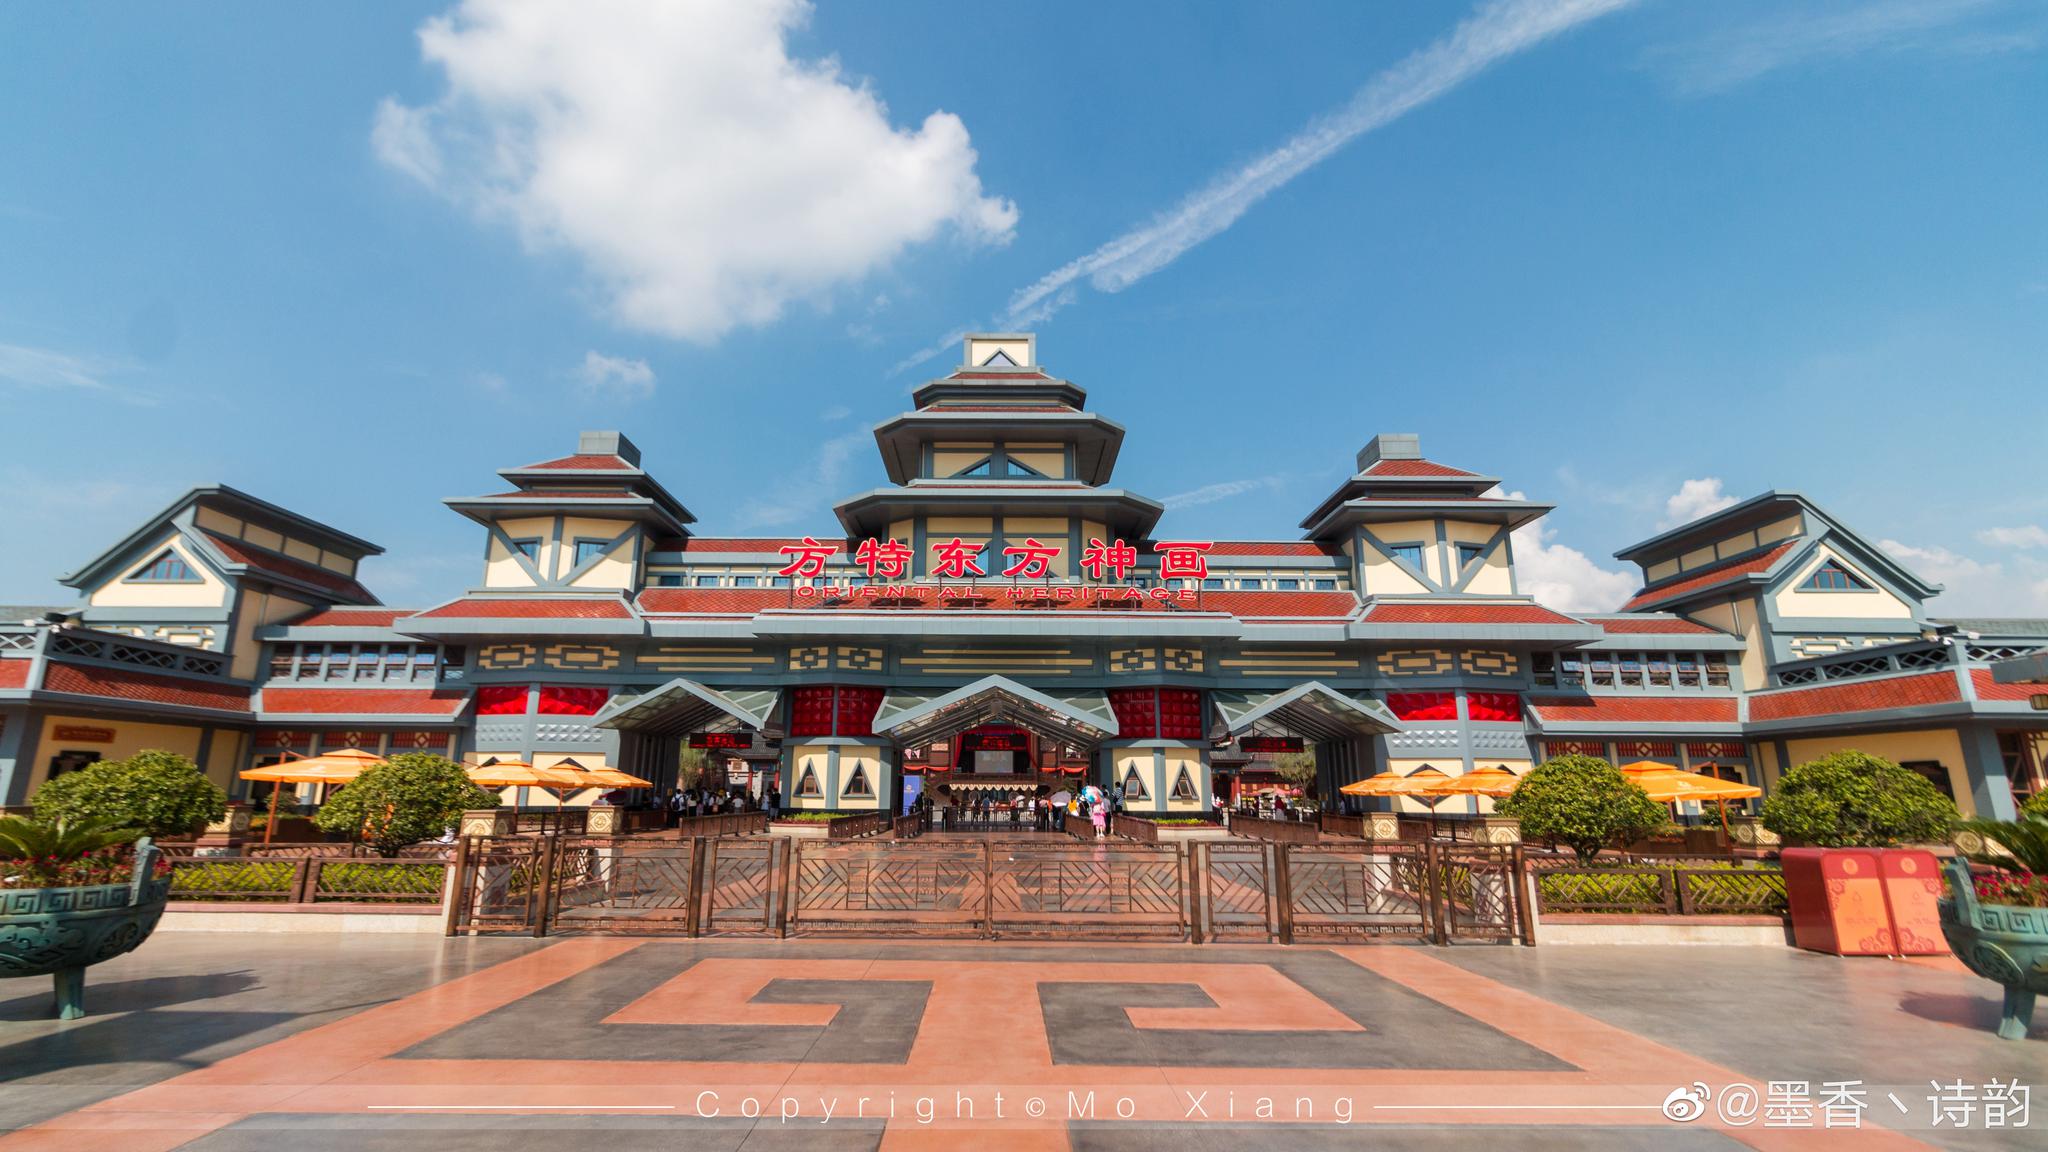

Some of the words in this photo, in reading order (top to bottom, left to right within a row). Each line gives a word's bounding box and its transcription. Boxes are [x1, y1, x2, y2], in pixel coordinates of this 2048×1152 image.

[778, 537, 1217, 580] 方特东方神画
[796, 585, 984, 599] ORIENTAL
[1005, 586, 1197, 600] HERITAGE
